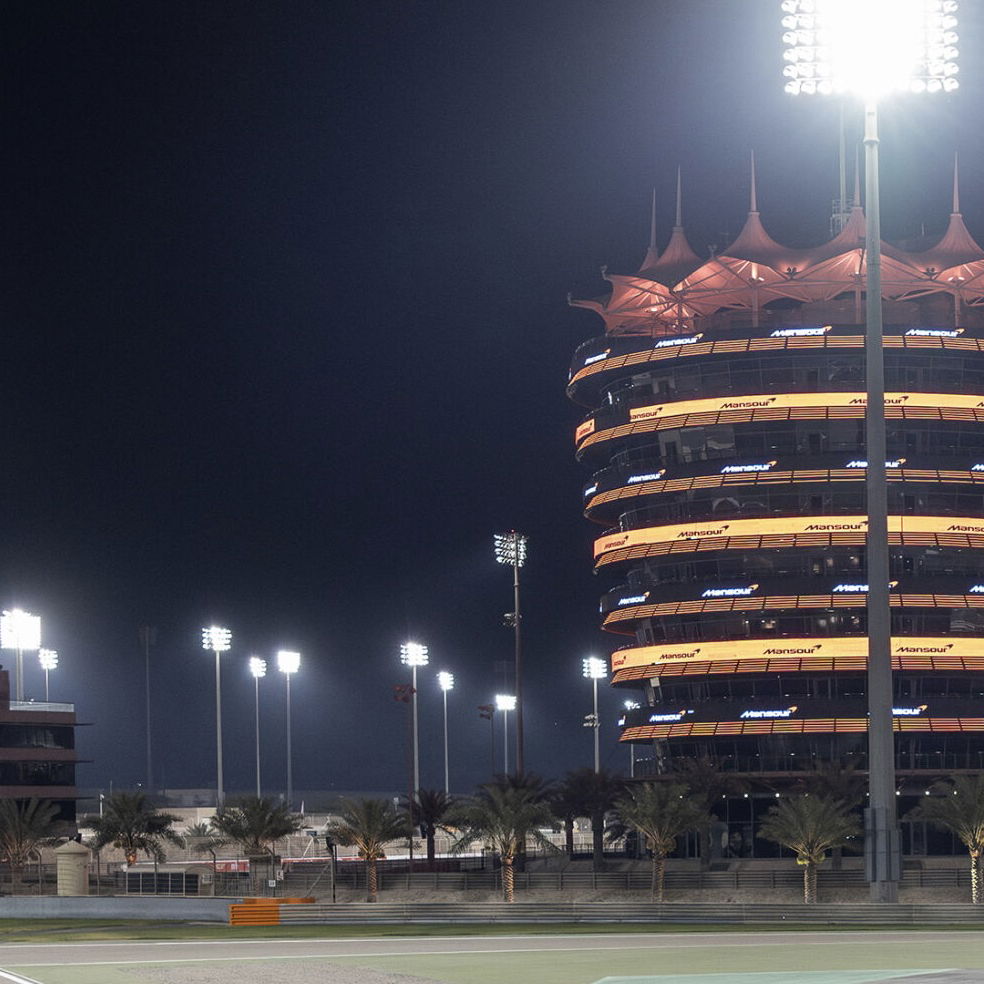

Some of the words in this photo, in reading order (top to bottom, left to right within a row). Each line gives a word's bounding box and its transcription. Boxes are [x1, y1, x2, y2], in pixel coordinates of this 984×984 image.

[771, 327, 826, 337] Mansour
[905, 328, 958, 338] Mansour
[655, 338, 698, 348] Mansour
[720, 401, 770, 409] Mansour
[630, 411, 658, 420] ansour
[721, 465, 771, 473] Mansour
[804, 523, 863, 531] Mansour
[677, 529, 724, 538] Mansour
[702, 587, 753, 597] Mansour
[763, 647, 816, 655] Mansour
[740, 710, 791, 718] Mansour
